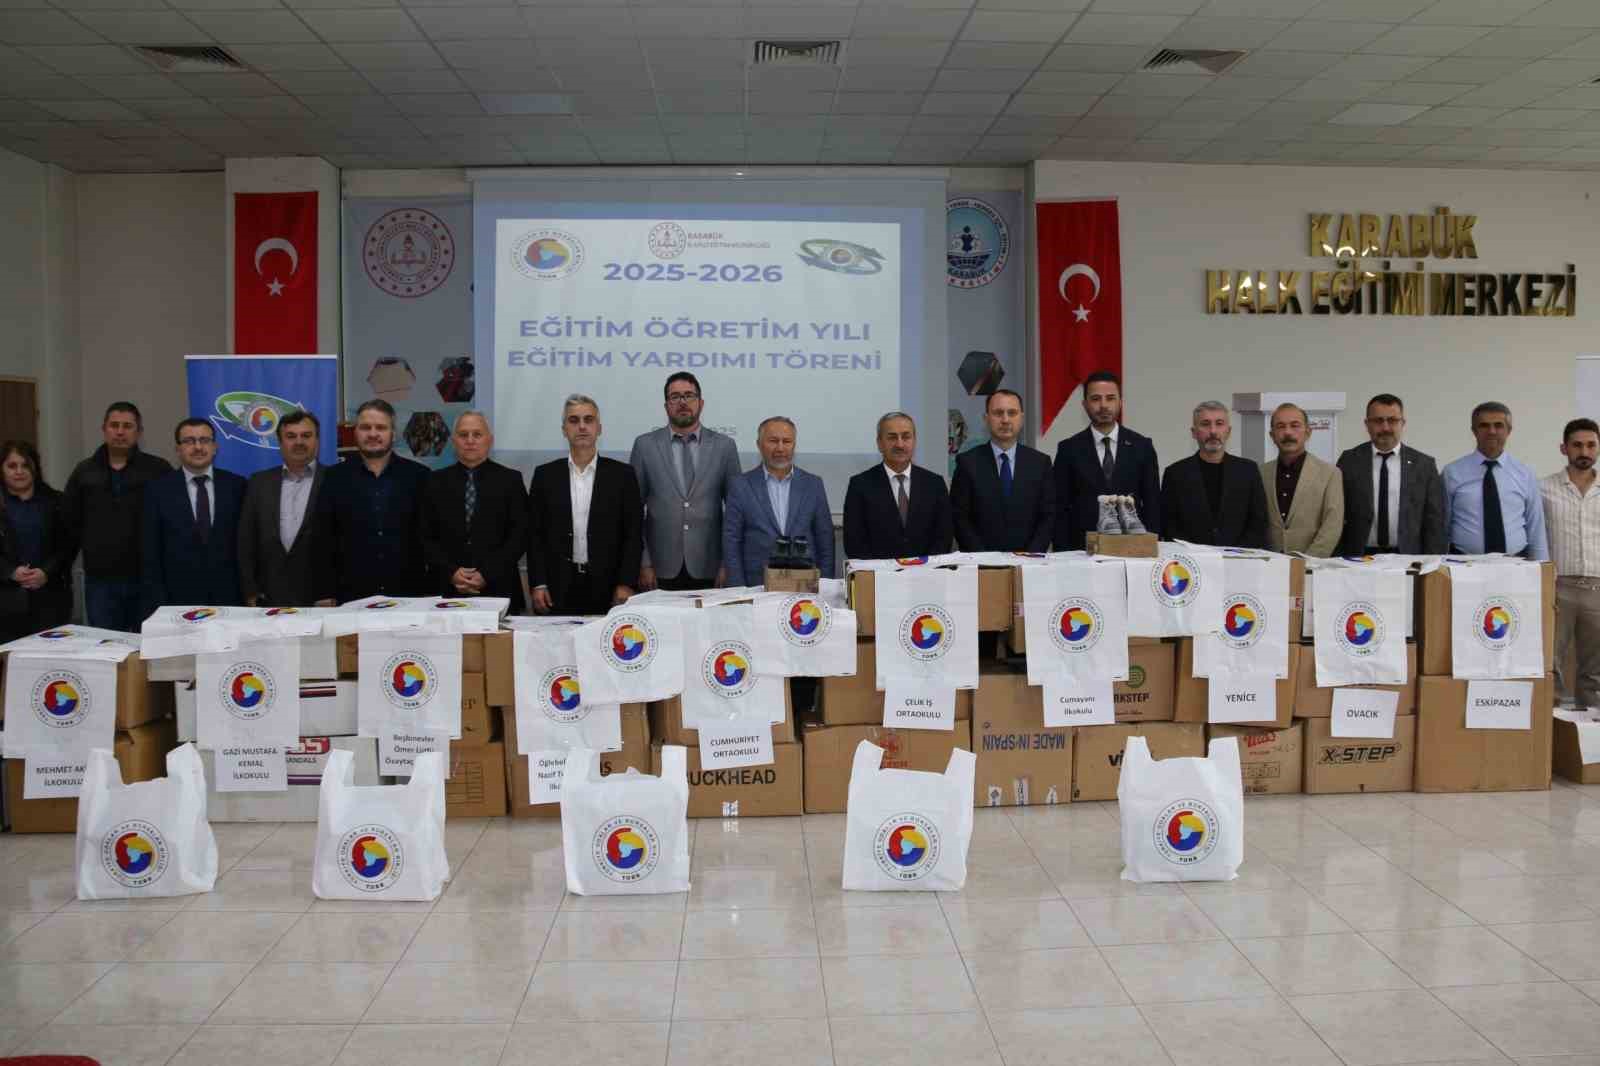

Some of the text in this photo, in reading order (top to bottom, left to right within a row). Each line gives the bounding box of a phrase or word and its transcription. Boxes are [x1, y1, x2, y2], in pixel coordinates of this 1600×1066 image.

[1310, 207, 1478, 259] KARABÜK
[603, 263, 783, 283] 2025-2026
[1206, 260, 1576, 317] HALK EĞİTİMİ MERKEZİ
[519, 315, 870, 340] EĞİTİM ÖĞRETİM YILI
[507, 347, 881, 370] EĞİTİM YARDIMI TÖRENİ
[1113, 692, 1150, 703] RKSTEP
[1225, 692, 1257, 702] YENİCE
[1474, 696, 1521, 708] ESKİPAZAR
[896, 710, 941, 719] ORTAOKULU
[1346, 708, 1379, 719] OVACIK
[710, 735, 760, 746] CUMHURİYET
[982, 733, 1065, 751] MADE IN SPAIN
[242, 747, 278, 756] MUSTAFA
[712, 748, 759, 758] ORTAOKULU
[238, 760, 264, 768] KEMAL
[36, 765, 86, 775] MEHMET AK
[687, 769, 776, 785] UCKHEAD
